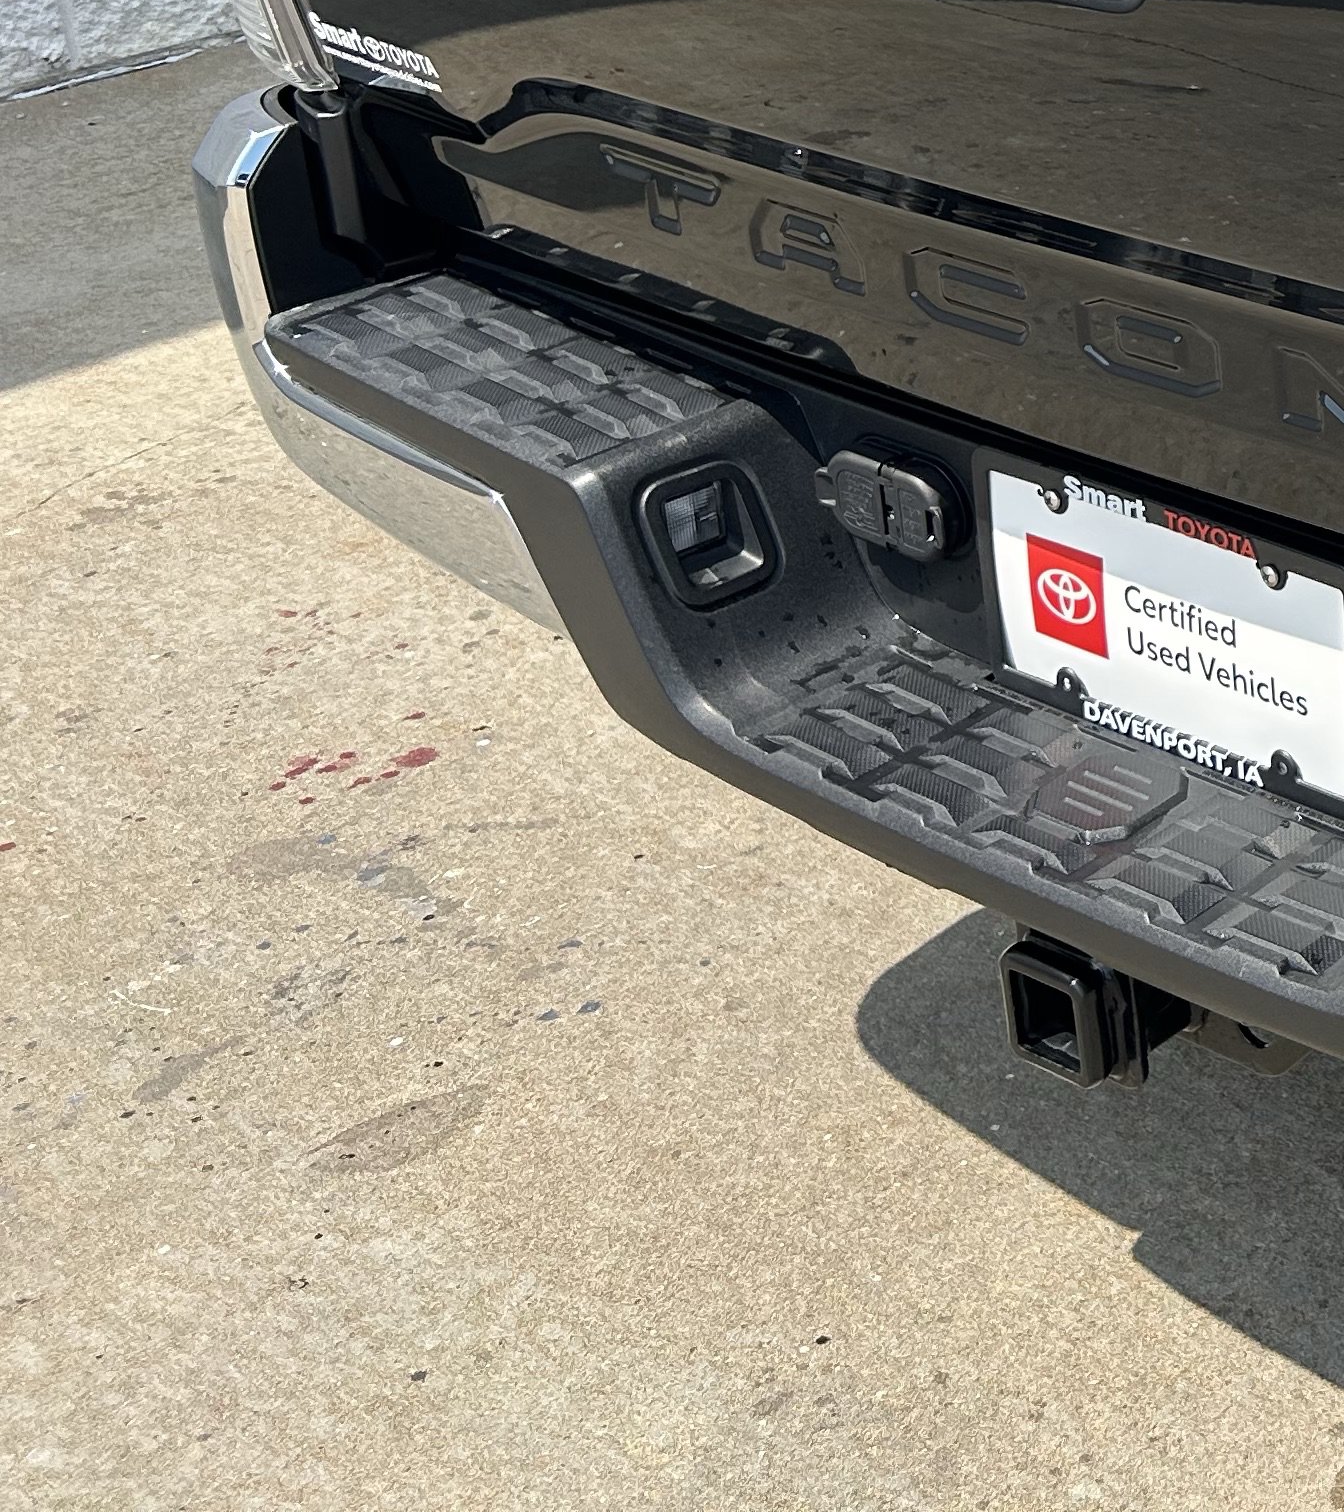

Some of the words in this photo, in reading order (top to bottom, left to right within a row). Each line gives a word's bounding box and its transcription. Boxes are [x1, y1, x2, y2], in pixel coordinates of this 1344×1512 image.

[308, 11, 367, 54] Smart
[379, 41, 440, 79] TOYOTA
[1062, 474, 1147, 522] Smart
[1163, 508, 1257, 560] TOYOTA
[1123, 584, 1238, 648] Certified
[1126, 626, 1191, 674] Used
[1198, 651, 1309, 716] Vehicles
[1083, 700, 1232, 776] DAVENPORT,
[1237, 760, 1265, 787] IA
